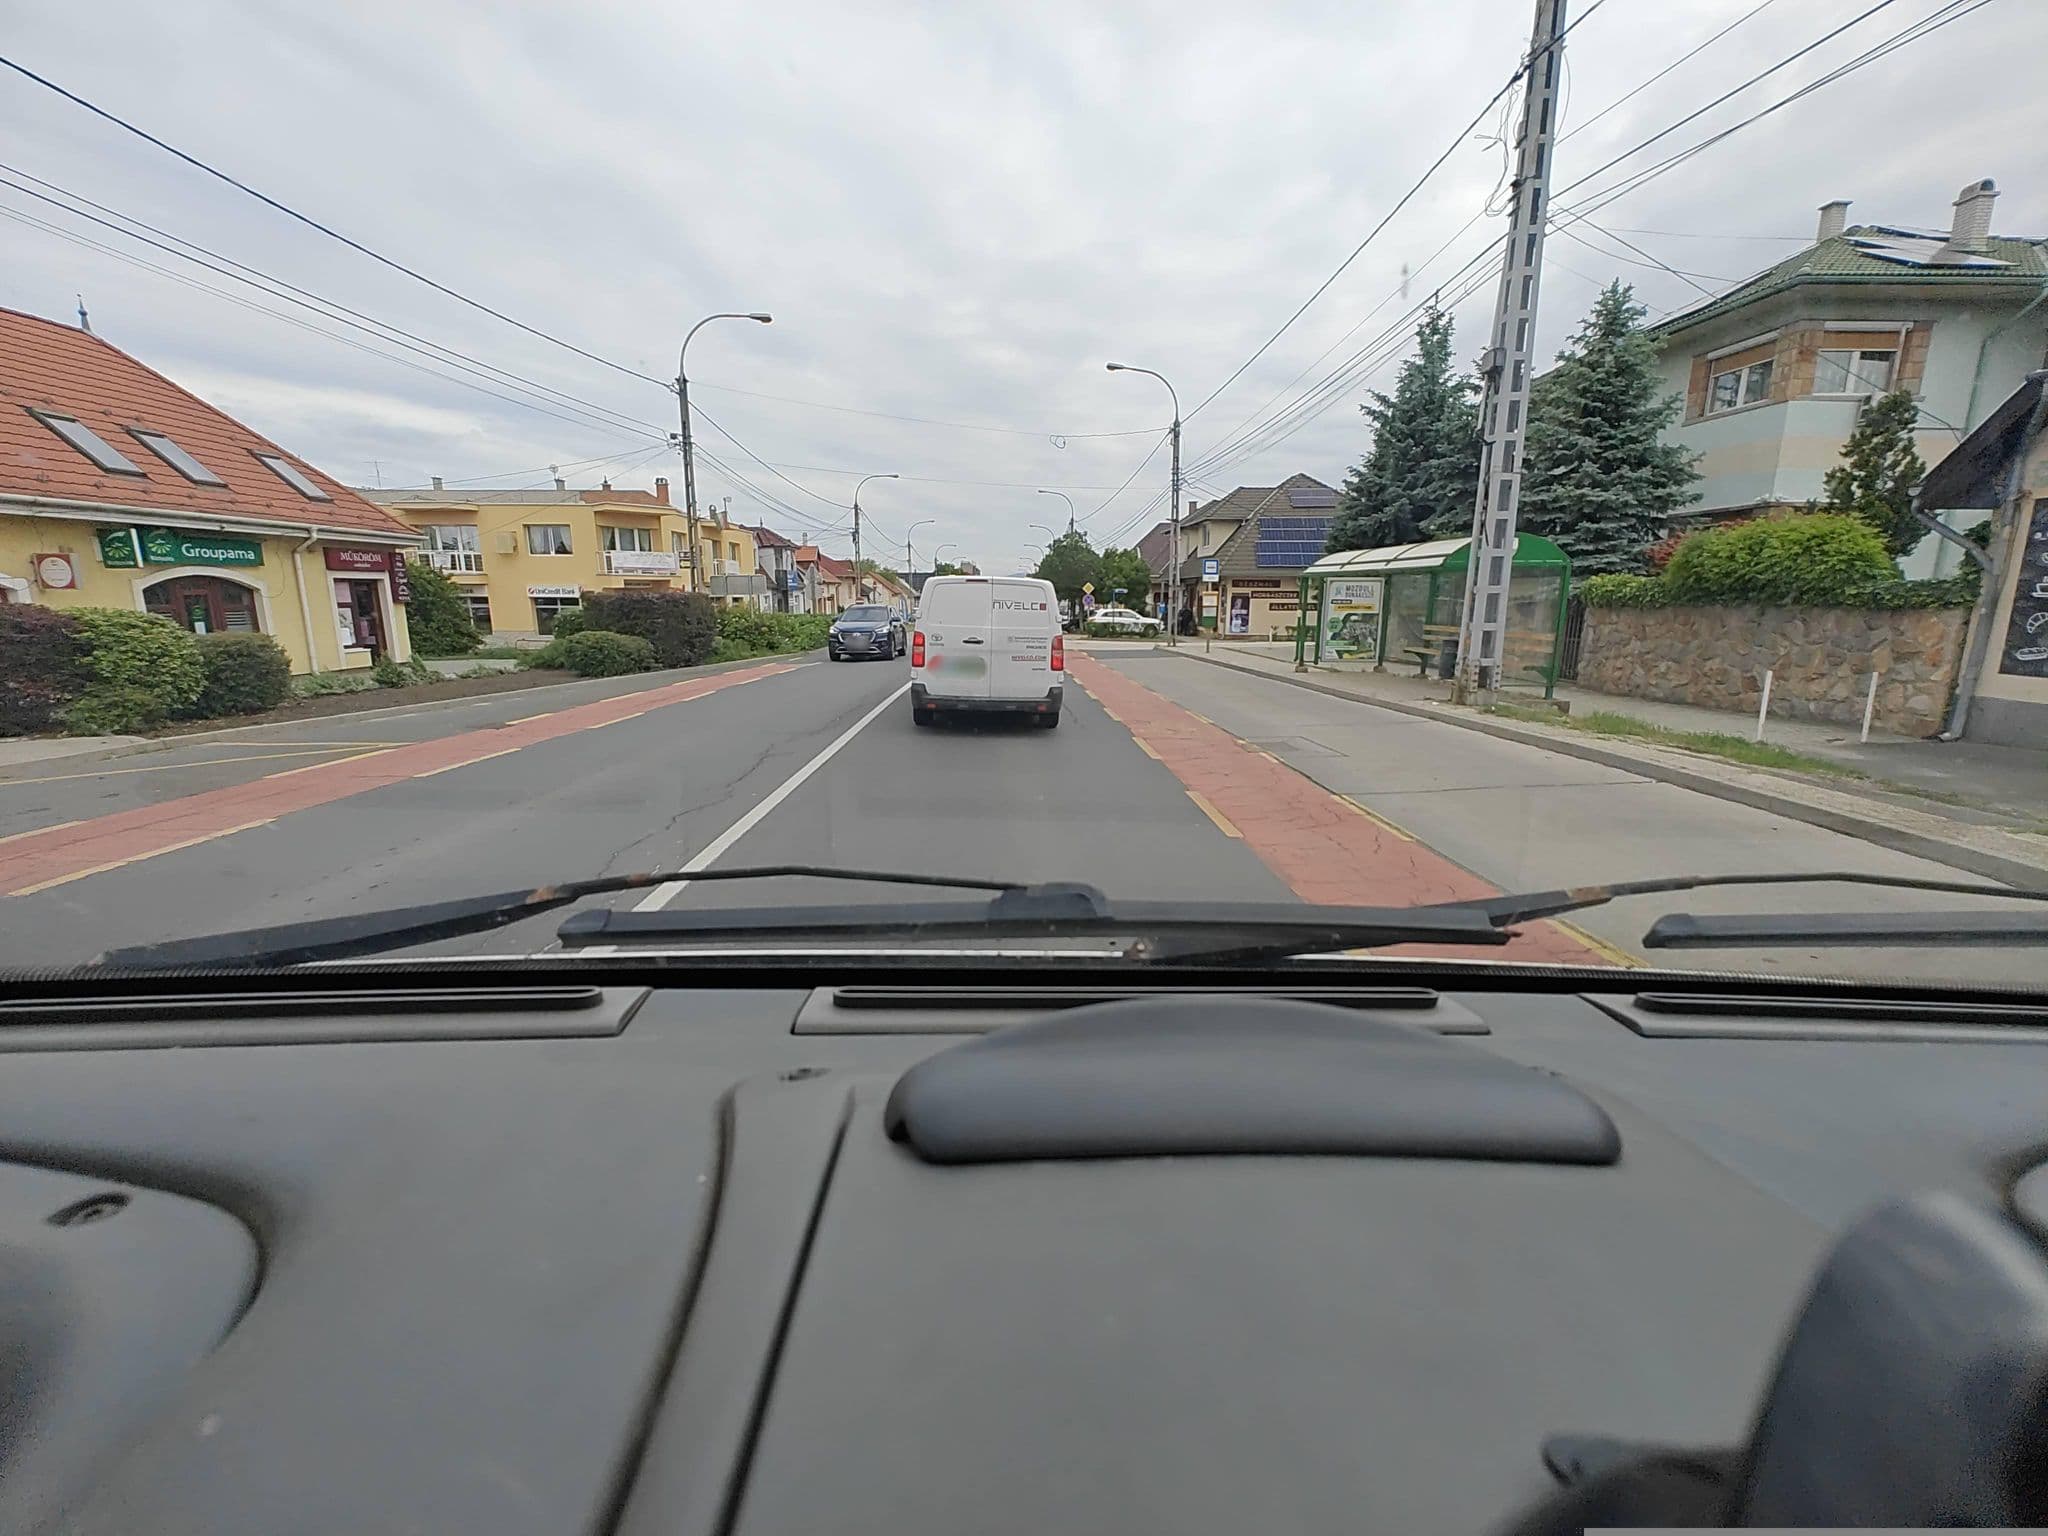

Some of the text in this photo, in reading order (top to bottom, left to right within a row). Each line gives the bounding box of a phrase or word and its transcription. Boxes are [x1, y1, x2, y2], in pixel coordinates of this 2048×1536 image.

[181, 543, 255, 560] Groupama
[536, 587, 576, 595] UniCredit Bank
